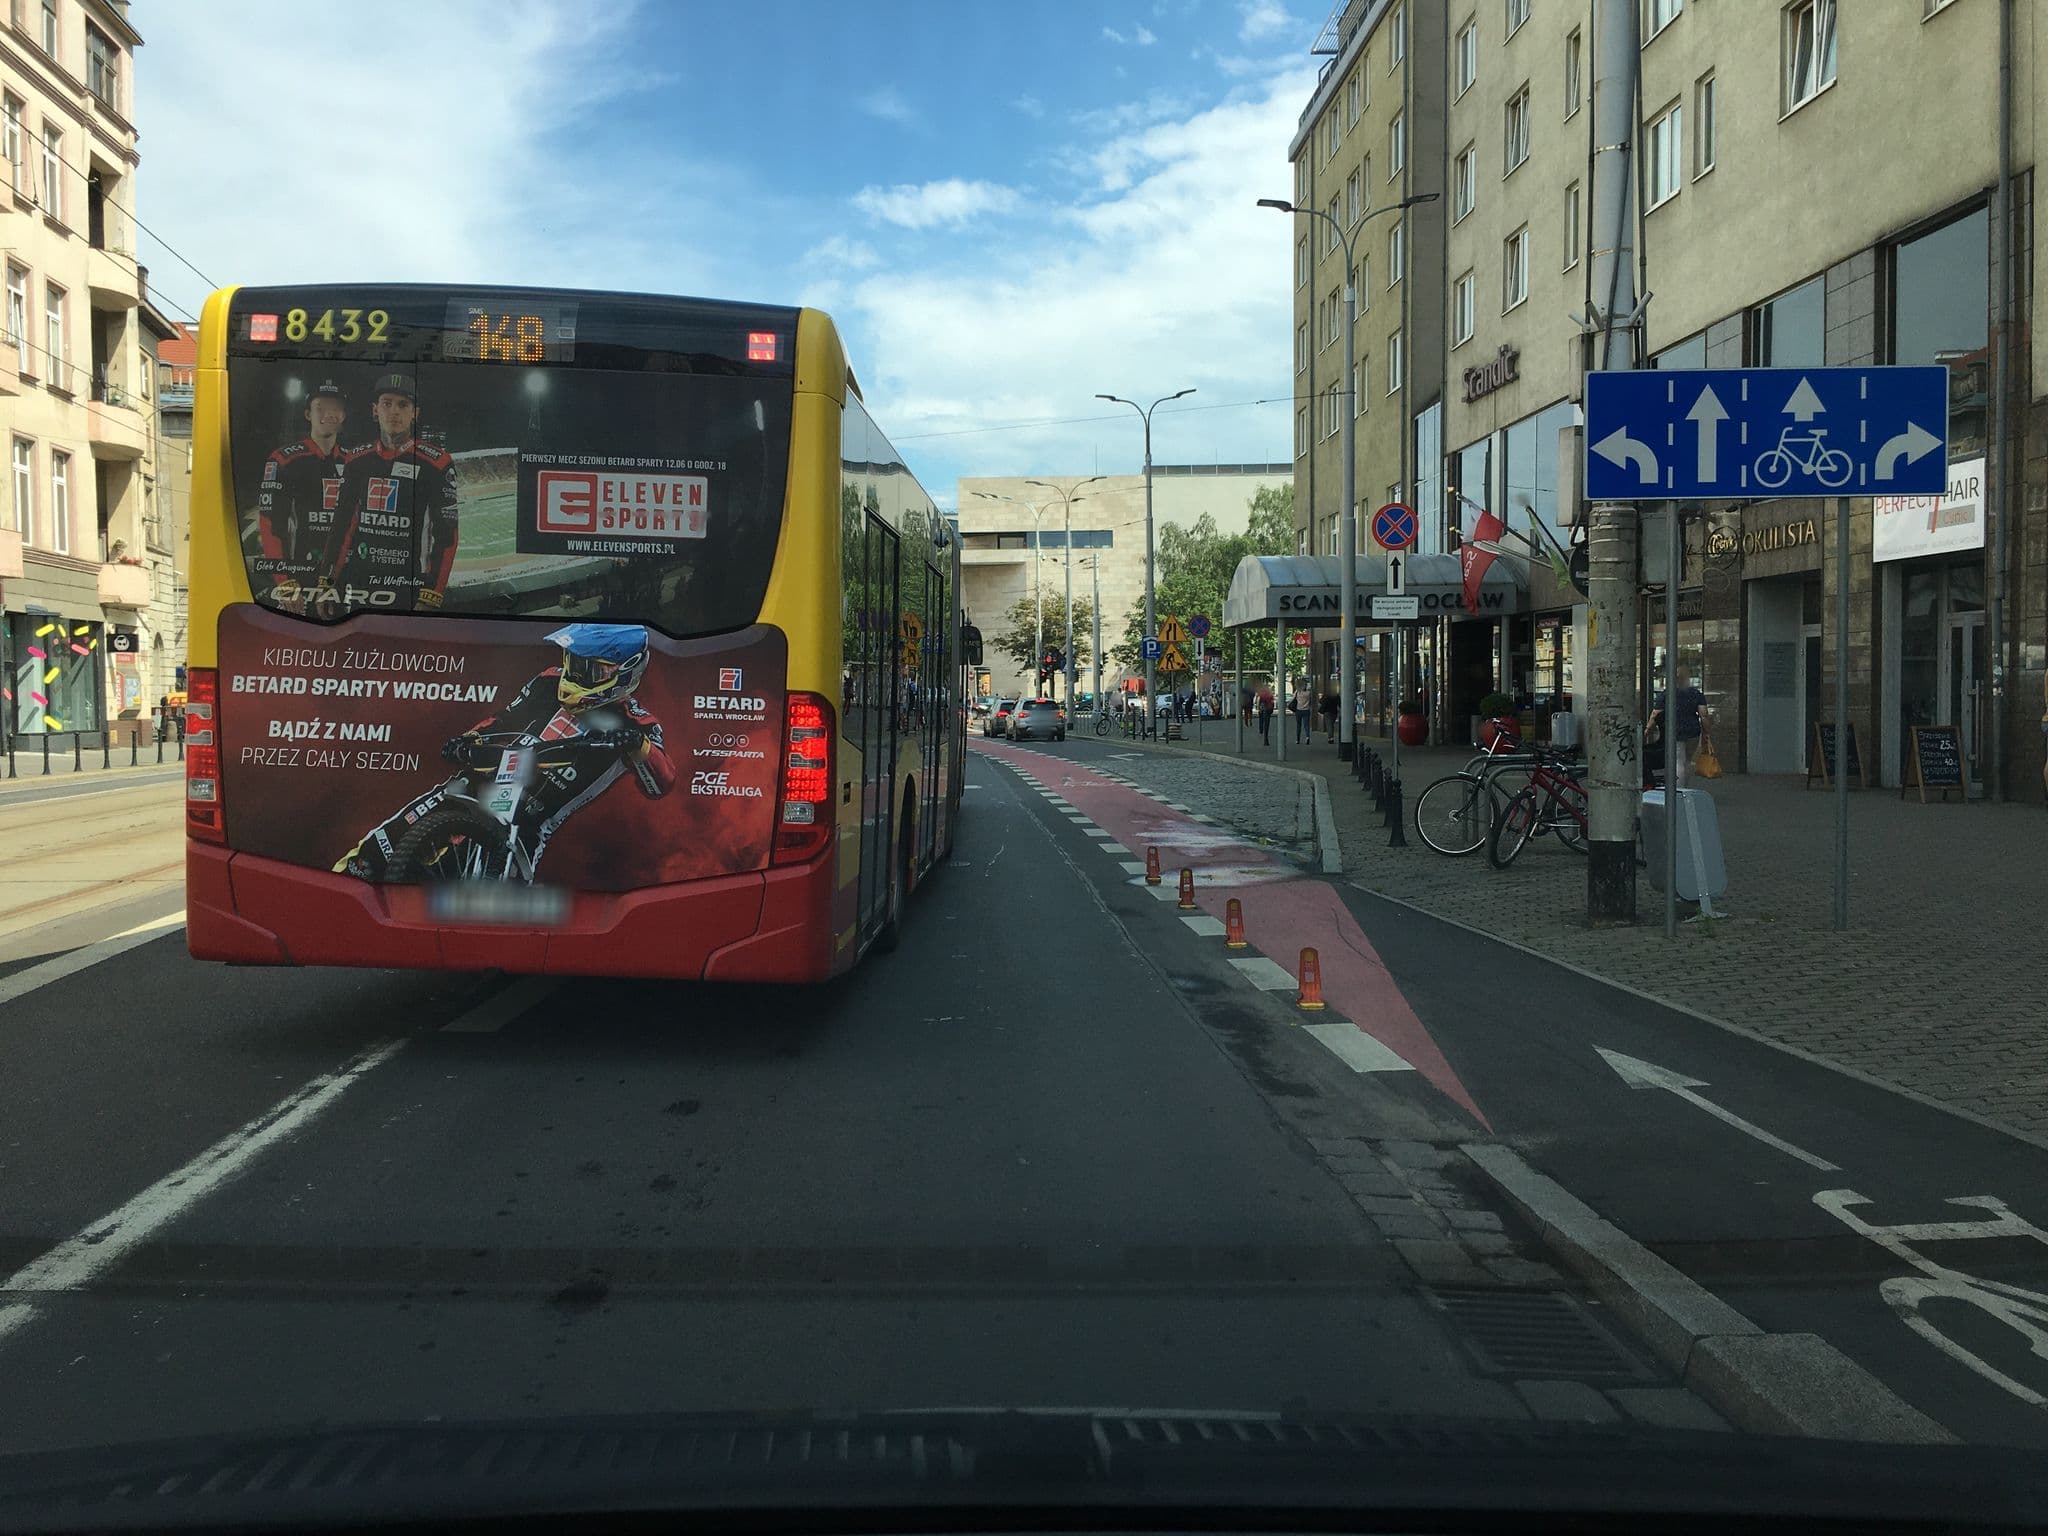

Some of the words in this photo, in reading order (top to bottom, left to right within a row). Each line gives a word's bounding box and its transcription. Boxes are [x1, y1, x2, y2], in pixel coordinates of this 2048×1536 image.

[285, 307, 390, 343] 8432
[470, 314, 544, 361] 148
[521, 453, 557, 464] PIERWSZY
[558, 455, 578, 465] MECZ
[579, 456, 606, 466] SEZONU
[607, 457, 636, 466] BETARD
[637, 458, 664, 468] SPARTY
[666, 459, 686, 469] 12.06
[717, 461, 727, 471] 18
[602, 480, 702, 506] ELEVEN
[308, 511, 335, 523] BET
[1741, 519, 1817, 555] OKULISTA
[566, 539, 676, 555] WWW.ELEVENSPORTS.PL
[256, 560, 274, 572] Gleb
[276, 561, 316, 574] Chugunov
[370, 556, 406, 566] SYSTEM
[368, 575, 382, 586] Tai
[270, 586, 397, 606] CITARO
[262, 647, 338, 669] KIBICUJ
[341, 647, 465, 674] ŻUŻLOWCOM
[231, 675, 308, 695] BETARD
[311, 677, 389, 698] SPARTY
[392, 681, 498, 703] WROCŁAW
[693, 695, 766, 711] BETARD
[693, 712, 724, 720] SPARTA
[725, 713, 765, 721] WROCŁAW
[268, 716, 321, 742] BĄDŹ
[323, 722, 336, 740] Z
[339, 722, 391, 742] NAMI
[240, 746, 301, 767] PRZEZ
[305, 749, 351, 769] CAŁY
[355, 751, 420, 772] SEZON
[692, 748, 765, 759] WTSSPARTA
[691, 771, 730, 785] PGE
[691, 784, 763, 797] EKSTRALIGA
